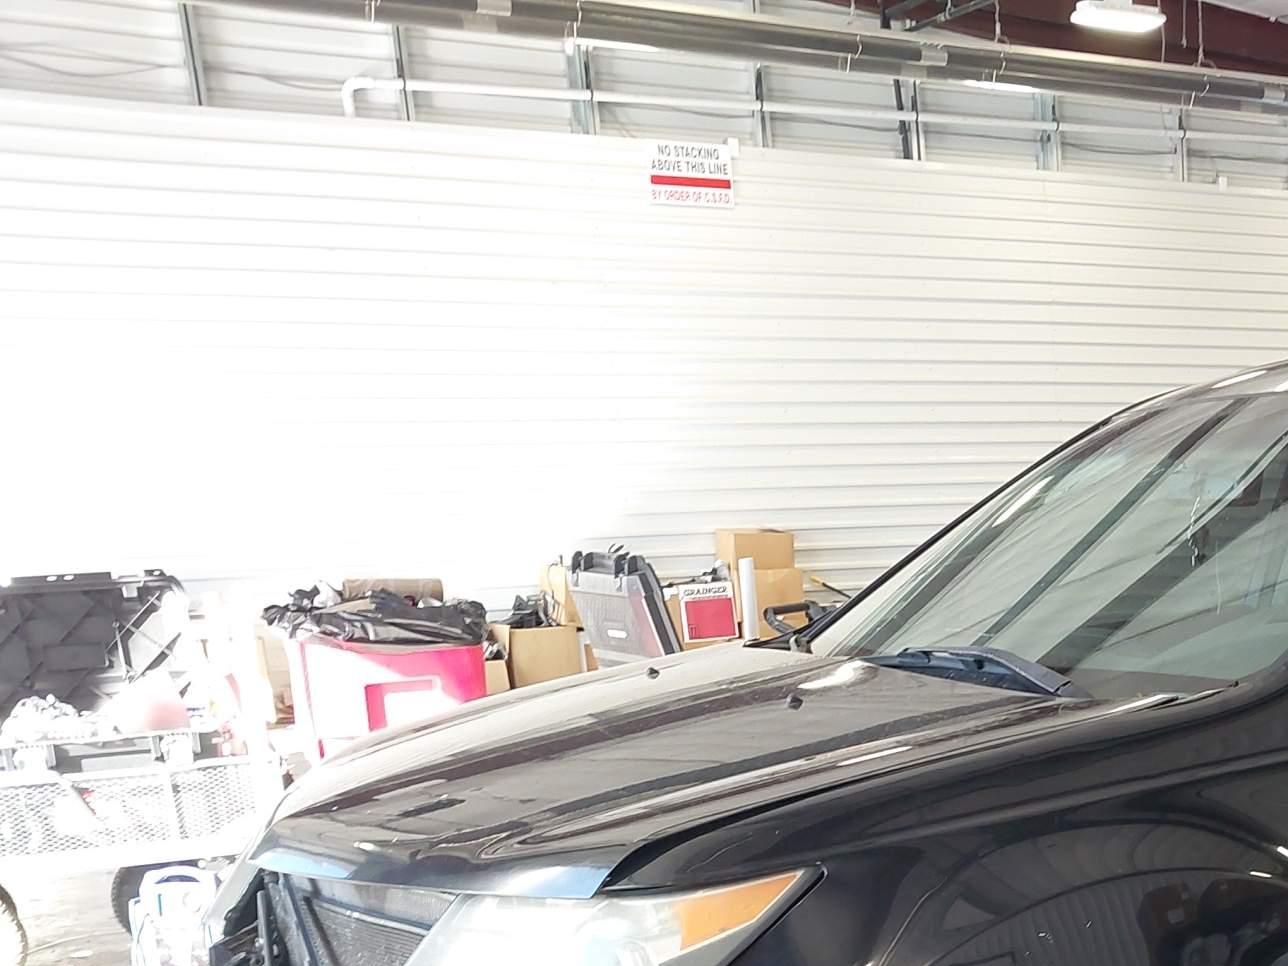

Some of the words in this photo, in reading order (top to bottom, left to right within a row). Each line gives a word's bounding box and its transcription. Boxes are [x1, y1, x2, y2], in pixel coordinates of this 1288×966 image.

[657, 144, 671, 157] NO
[673, 145, 720, 160] STACKING
[651, 159, 682, 172] ABOVE
[685, 161, 706, 174] THIS
[708, 163, 728, 175] LINE
